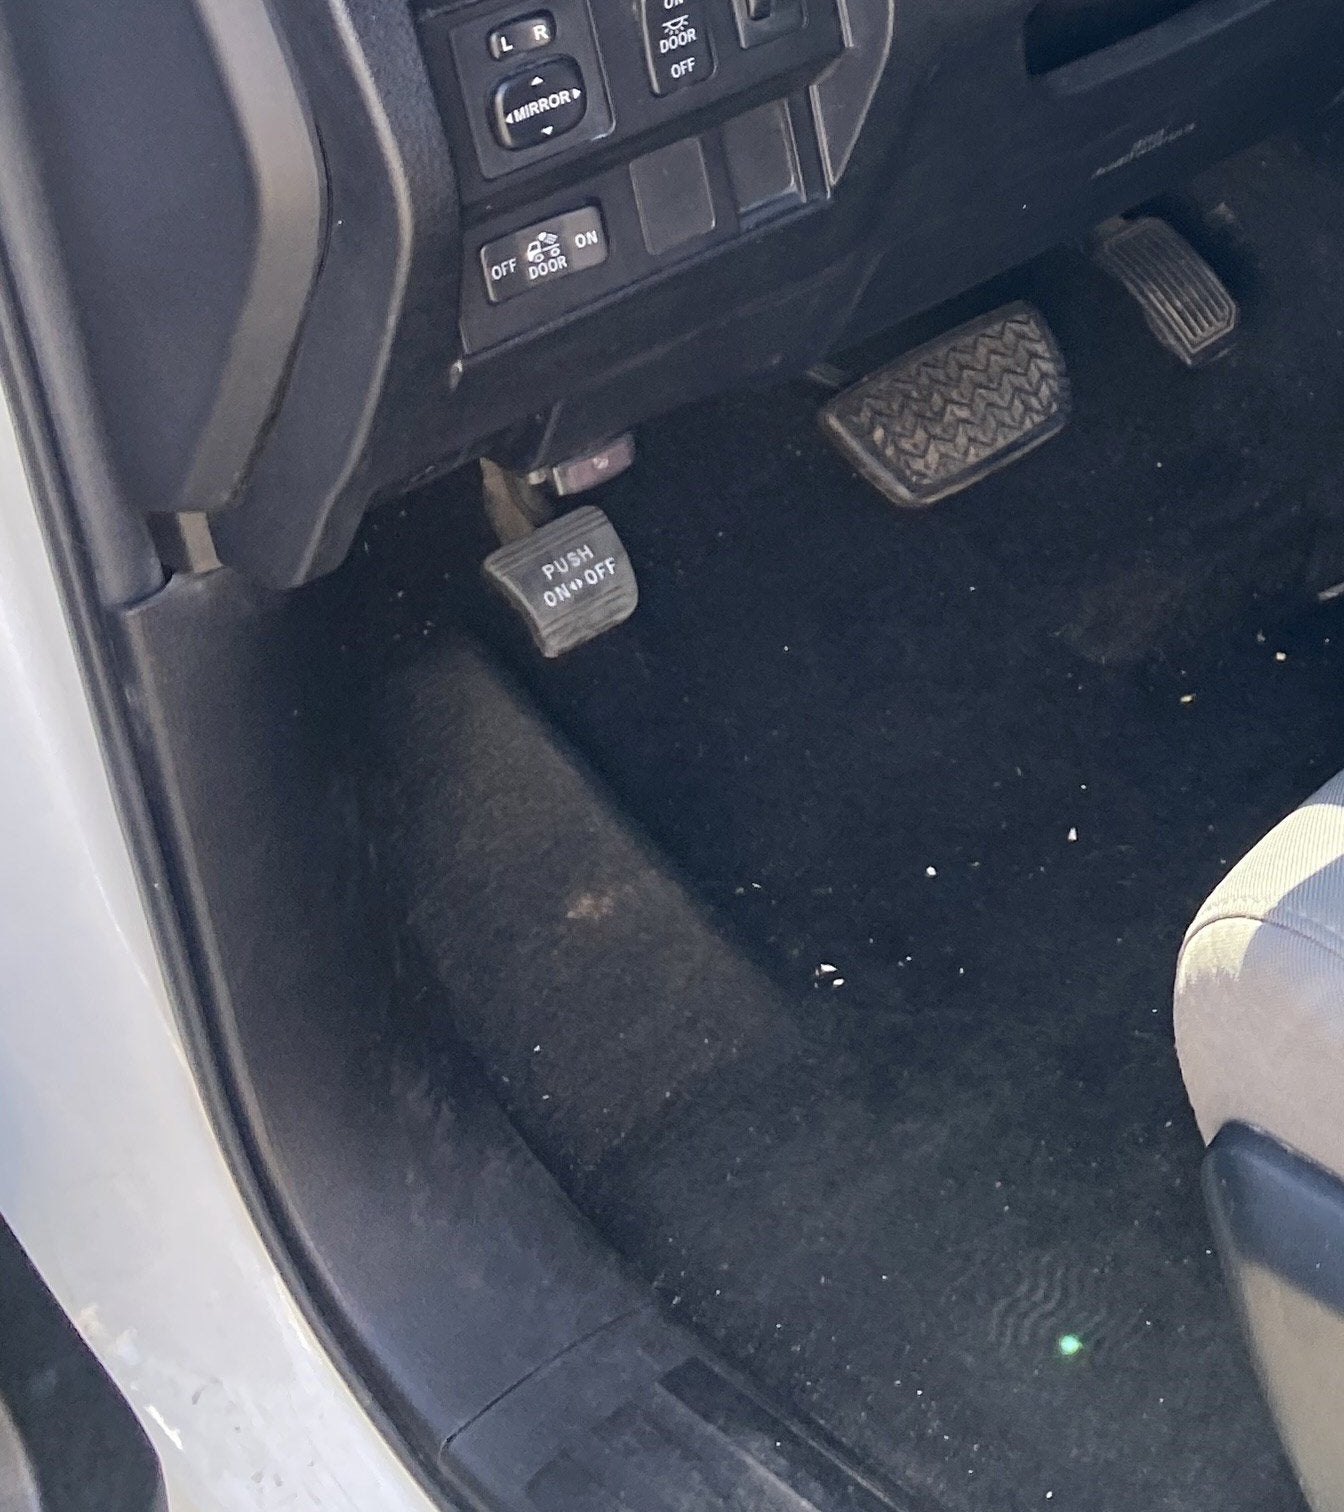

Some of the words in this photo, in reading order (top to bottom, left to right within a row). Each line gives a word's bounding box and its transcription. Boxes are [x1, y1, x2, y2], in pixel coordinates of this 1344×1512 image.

[500, 36, 514, 52] L
[532, 24, 550, 40] R
[659, 28, 697, 54] DOOR
[670, 57, 696, 79] OFF
[513, 90, 572, 123] MIRROR
[574, 230, 599, 249] ON
[491, 258, 518, 281] OFF
[528, 255, 568, 280] DOOR
[541, 544, 594, 581] PUSH
